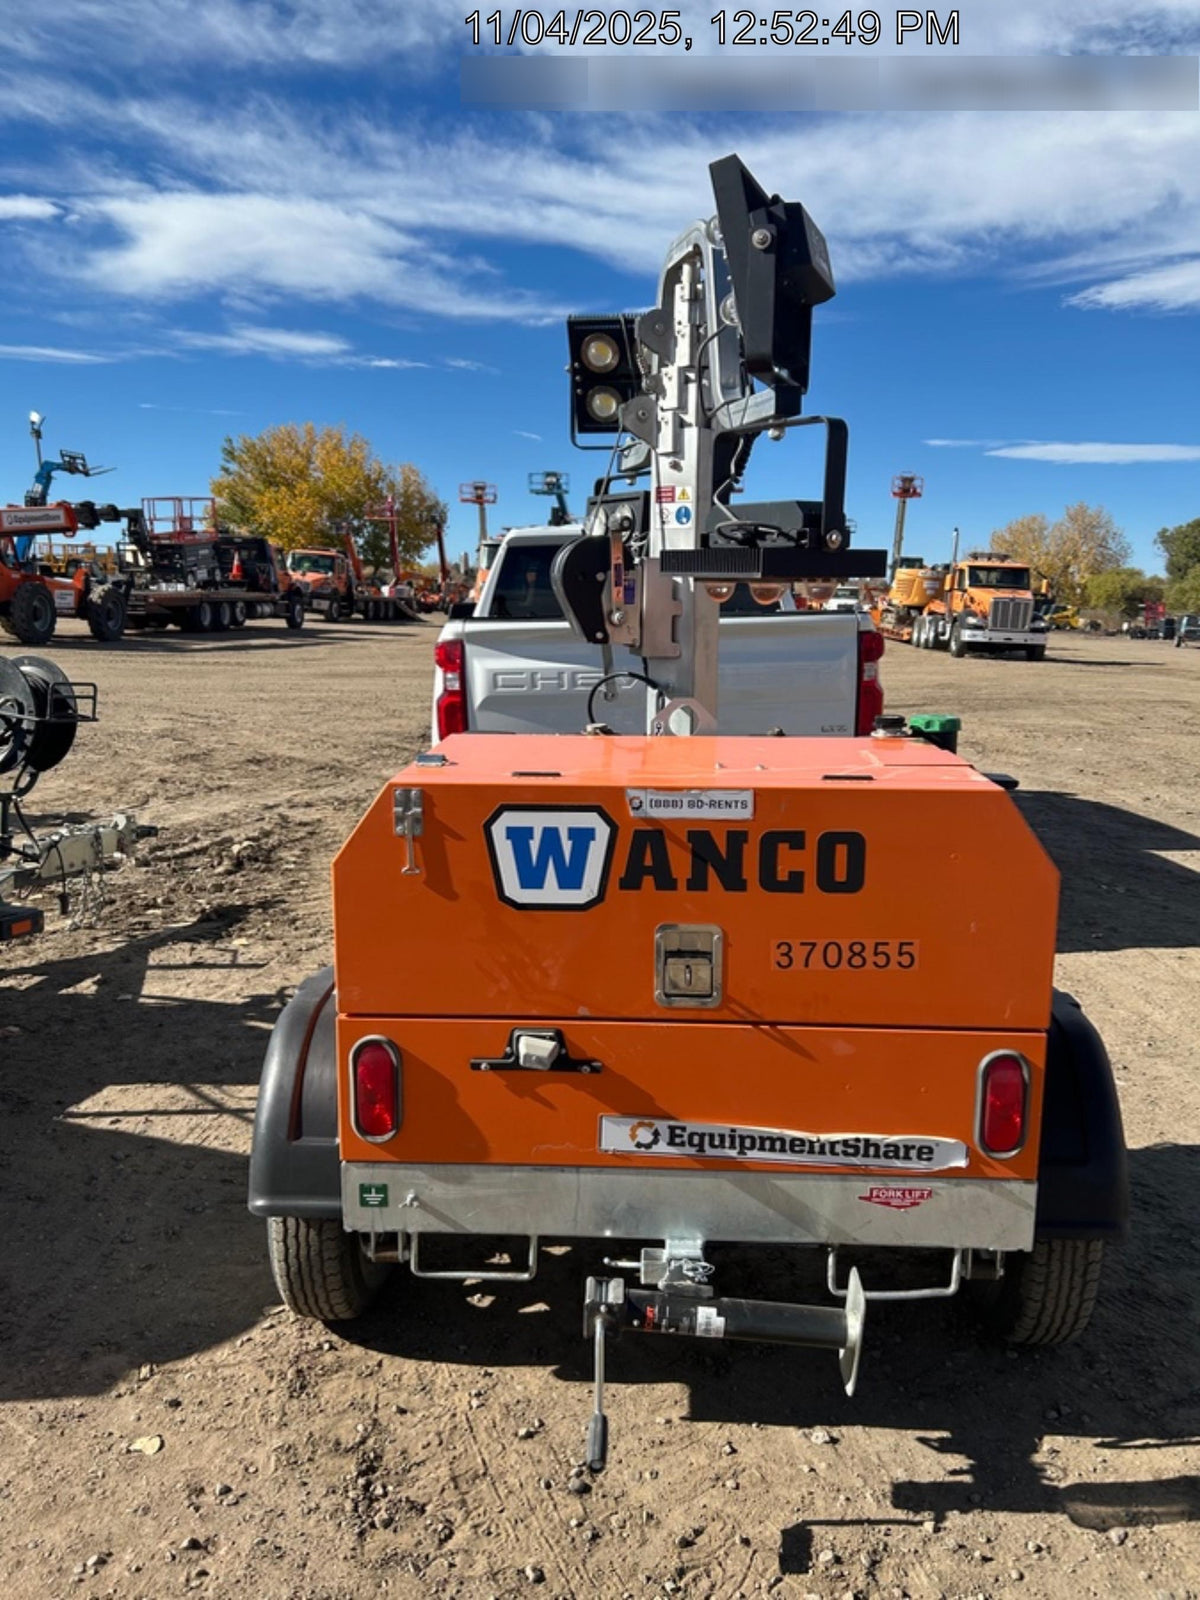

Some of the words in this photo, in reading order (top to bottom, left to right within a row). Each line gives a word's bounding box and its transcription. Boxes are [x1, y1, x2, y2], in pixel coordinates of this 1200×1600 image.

[505, 825, 867, 894] WANCO
[776, 941, 916, 970] 370855
[666, 1125, 936, 1162] EquipmentShare
